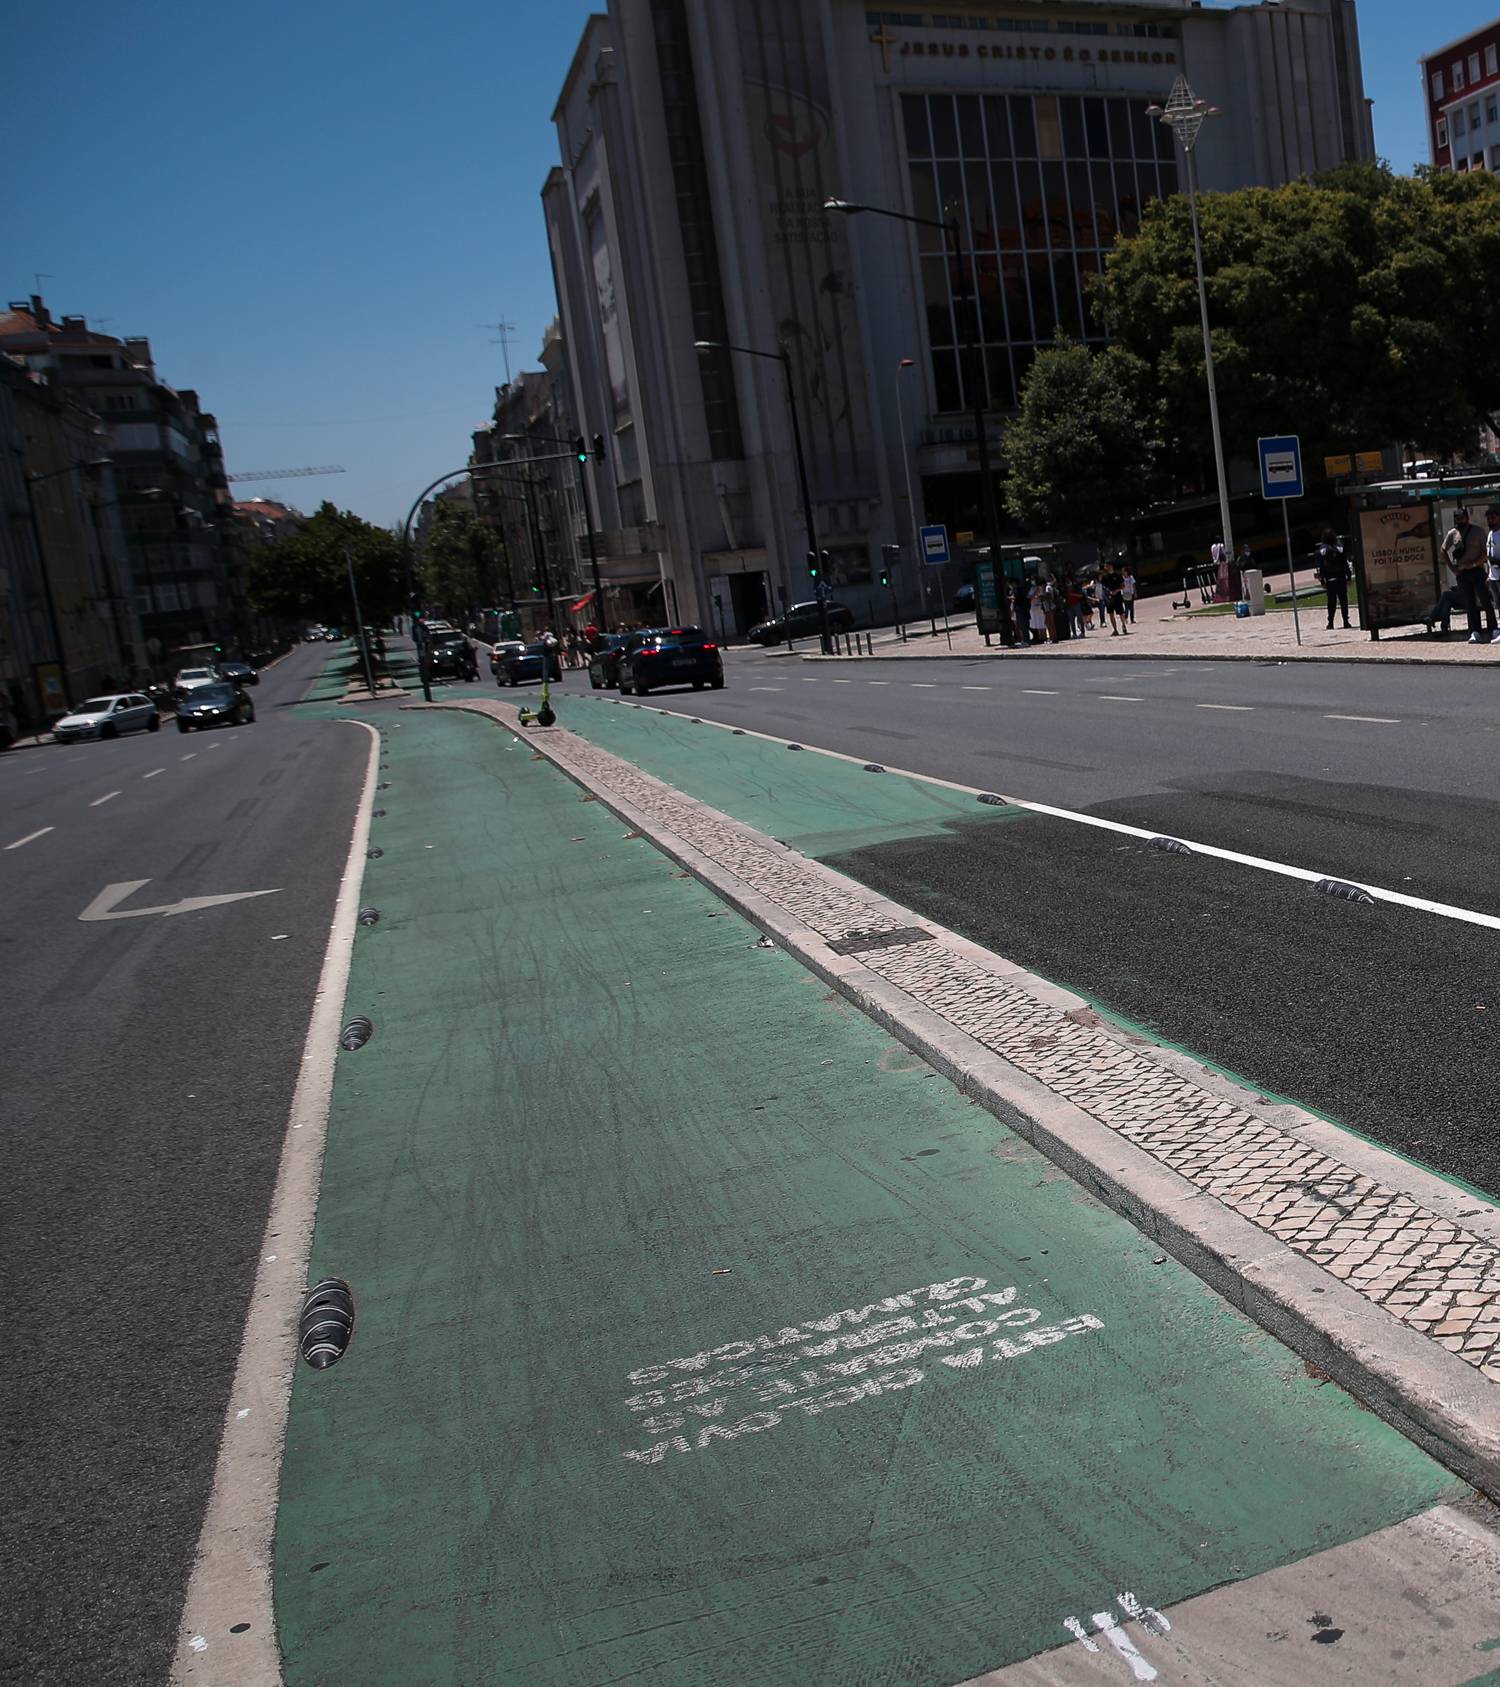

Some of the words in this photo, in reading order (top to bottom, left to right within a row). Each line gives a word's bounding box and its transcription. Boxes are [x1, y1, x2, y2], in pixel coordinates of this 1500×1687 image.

[900, 42, 969, 57] JESUS
[977, 44, 1056, 60] CRISTO
[1098, 48, 1176, 64] SENHOR
[1374, 558, 1387, 566] FOI
[1399, 545, 1425, 555] NUNCA
[751, 1308, 1042, 1401] COMBATE
[942, 1313, 1105, 1368] ESTA
[641, 1398, 728, 1434] AS
